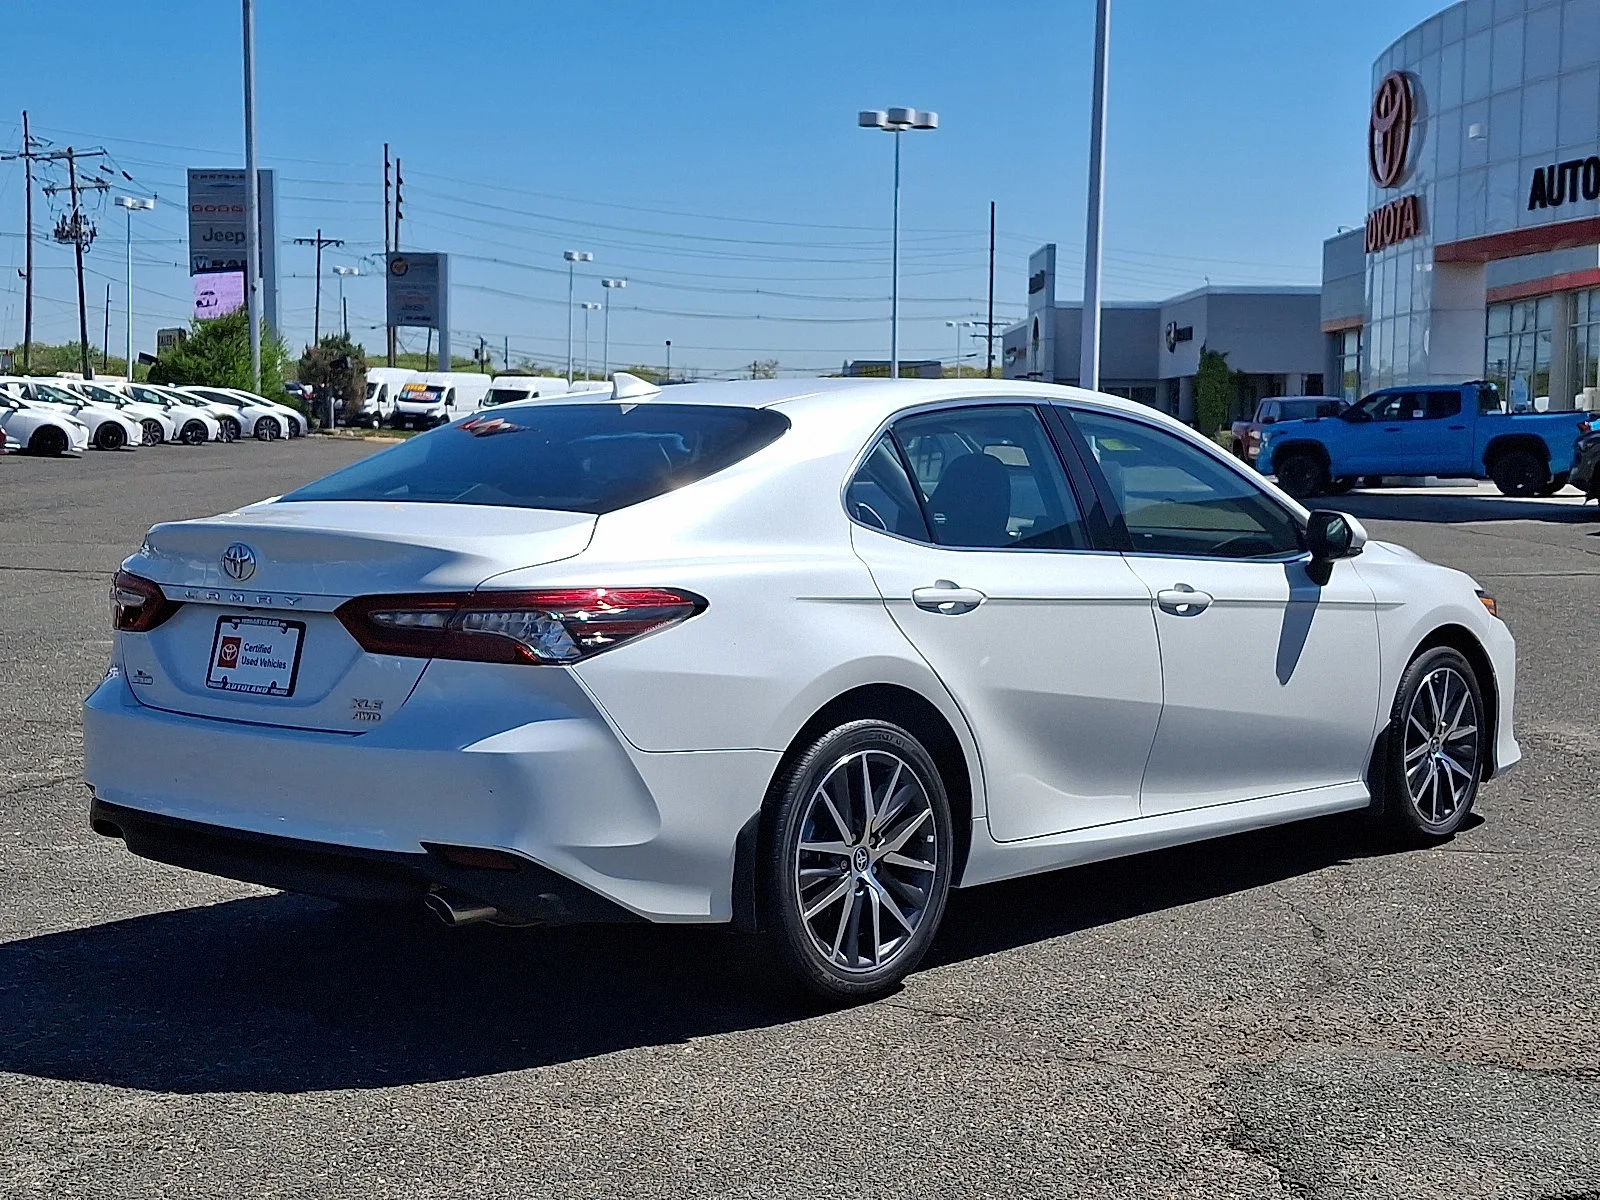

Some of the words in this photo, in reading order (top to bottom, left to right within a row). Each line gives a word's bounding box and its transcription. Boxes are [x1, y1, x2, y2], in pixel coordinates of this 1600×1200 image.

[1528, 156, 1600, 211] AUTO
[192, 204, 246, 212] DODG
[203, 227, 246, 245] Jeep
[184, 589, 303, 606] CAMRY
[243, 642, 272, 654] Certified
[241, 655, 259, 667] Used
[260, 657, 287, 670] Vehicles
[225, 682, 269, 694] AUTOLAND
[351, 697, 384, 710] XLE
[352, 711, 382, 721] AWD
